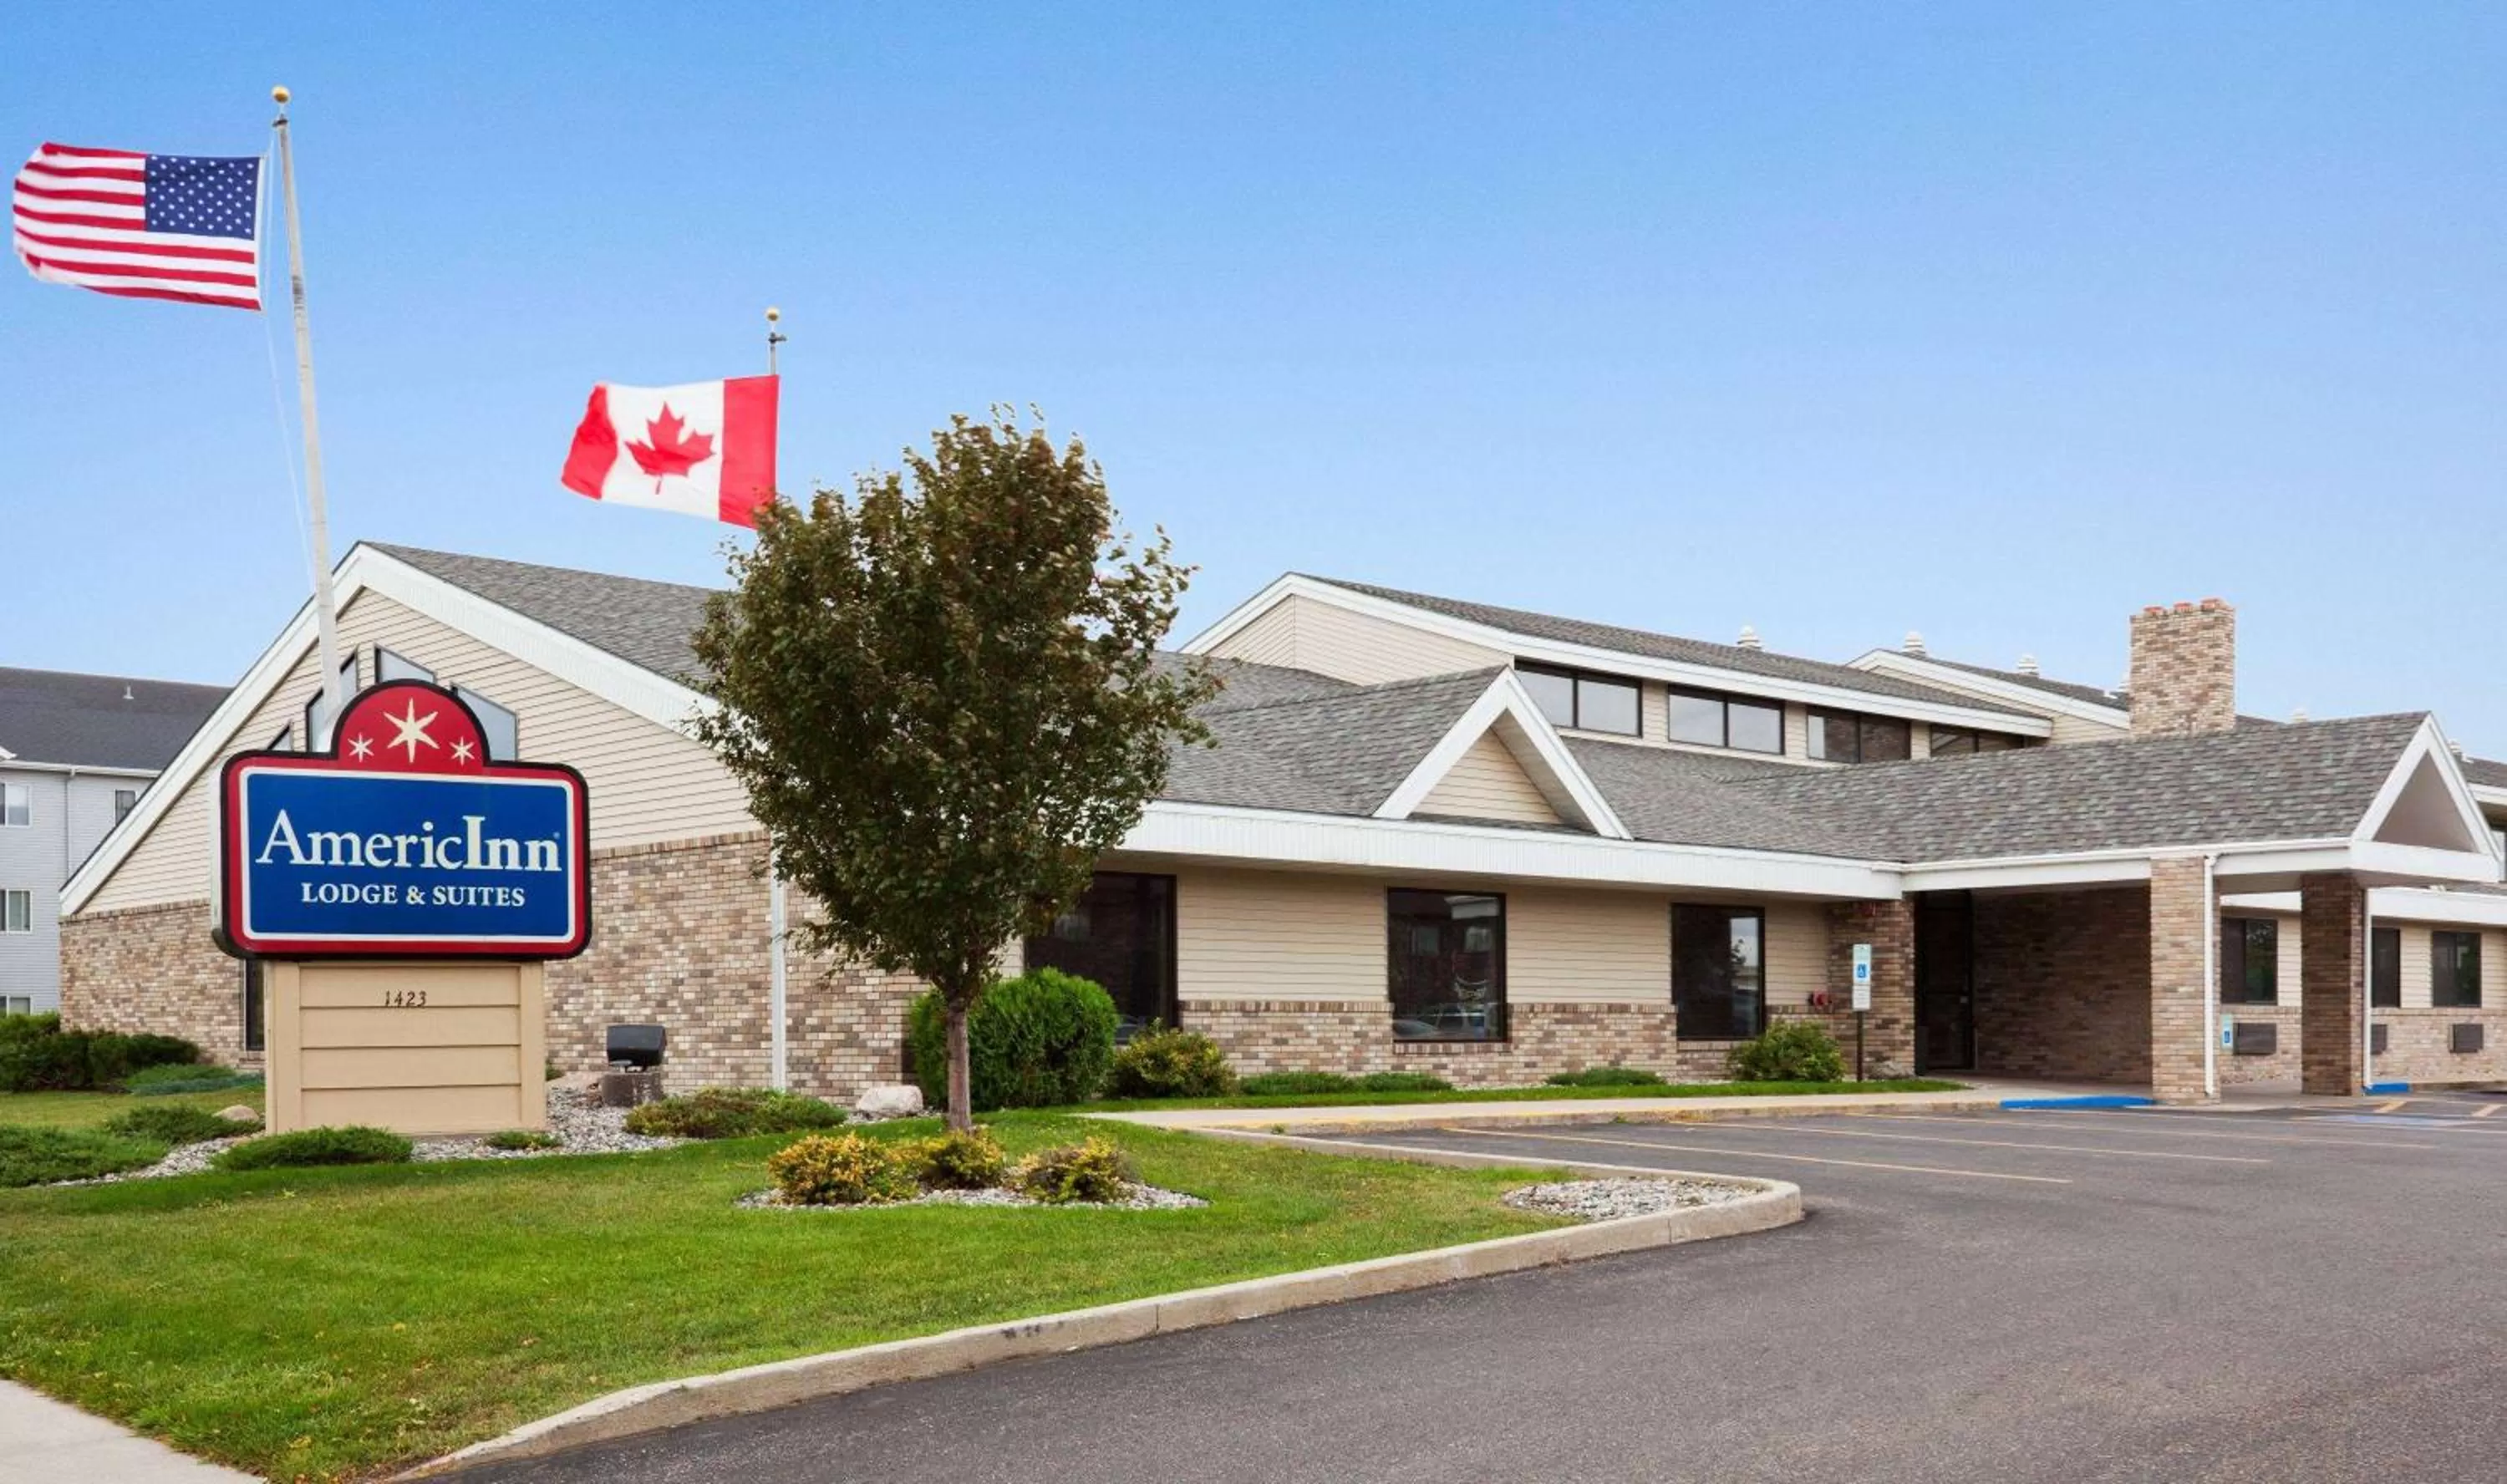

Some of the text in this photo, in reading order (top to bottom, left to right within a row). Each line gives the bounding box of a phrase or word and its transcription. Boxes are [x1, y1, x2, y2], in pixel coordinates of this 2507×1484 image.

[256, 809, 562, 872] AmericInn
[301, 883, 525, 906] LODGE & SUITES
[384, 990, 427, 1008] 1423
